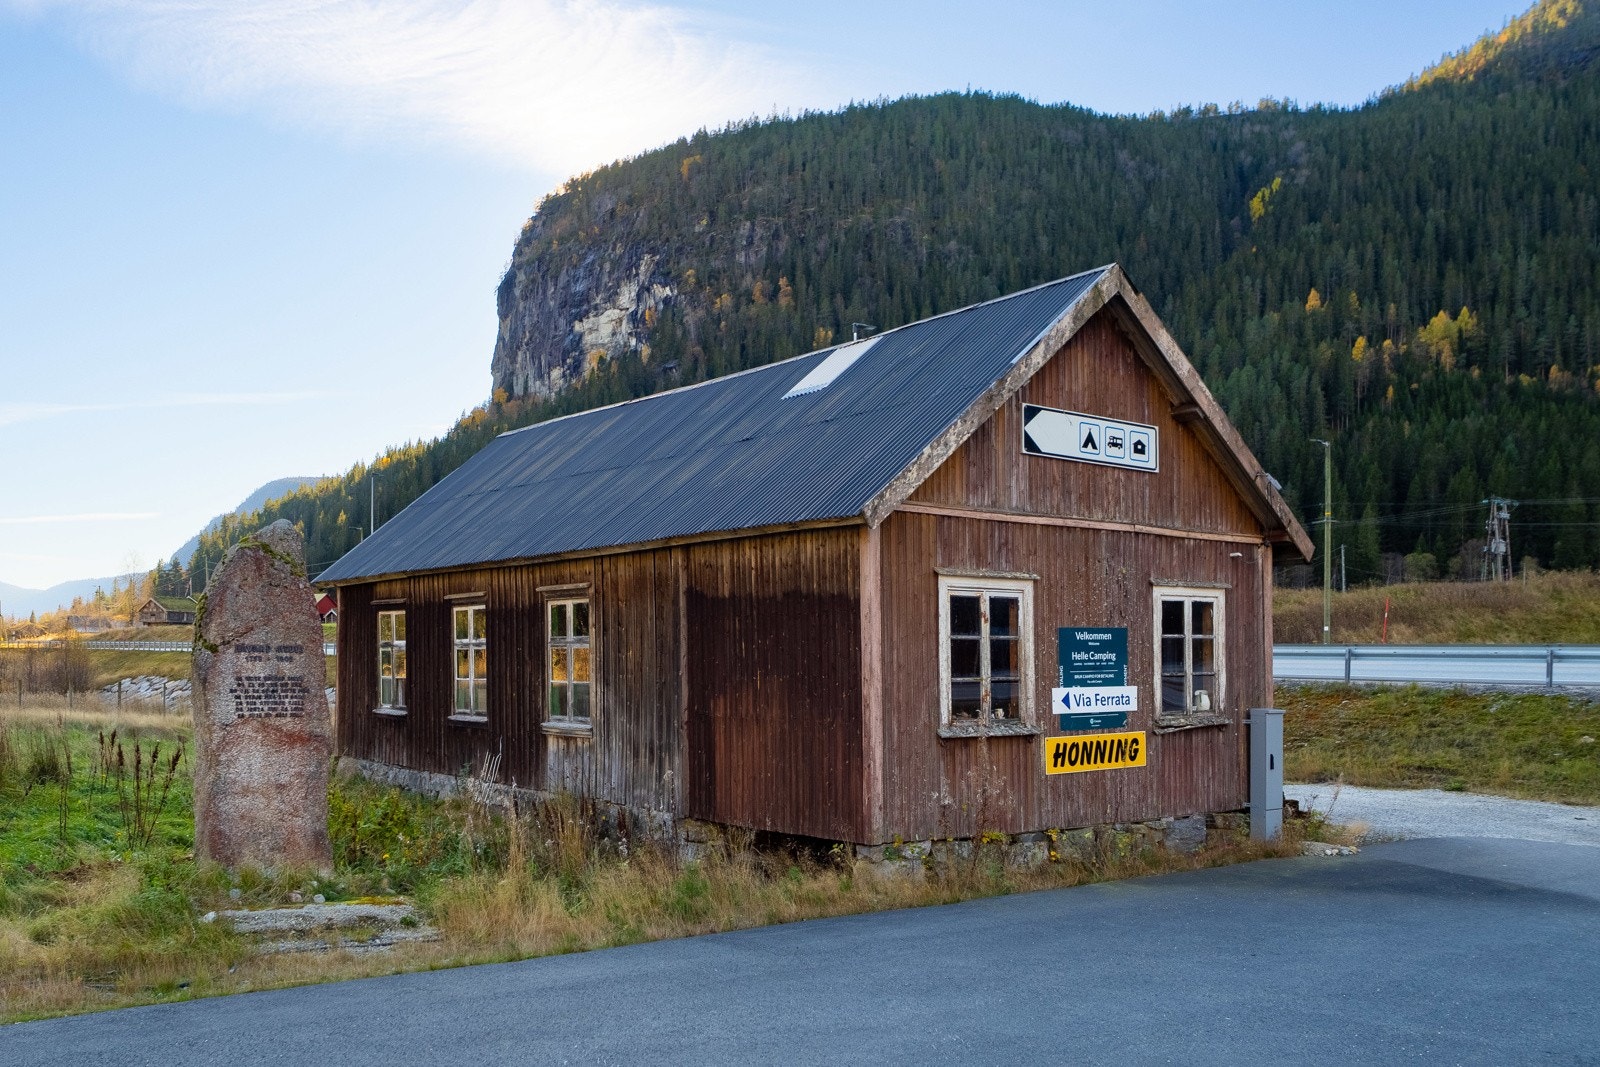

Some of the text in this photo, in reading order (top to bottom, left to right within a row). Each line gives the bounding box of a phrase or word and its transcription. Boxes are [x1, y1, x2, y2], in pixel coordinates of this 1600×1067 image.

[1075, 631, 1112, 640] Velkommen
[1071, 651, 1116, 661] Helle Camping
[1073, 693, 1131, 707] Via Ferrata
[1053, 737, 1140, 768] HONNING
